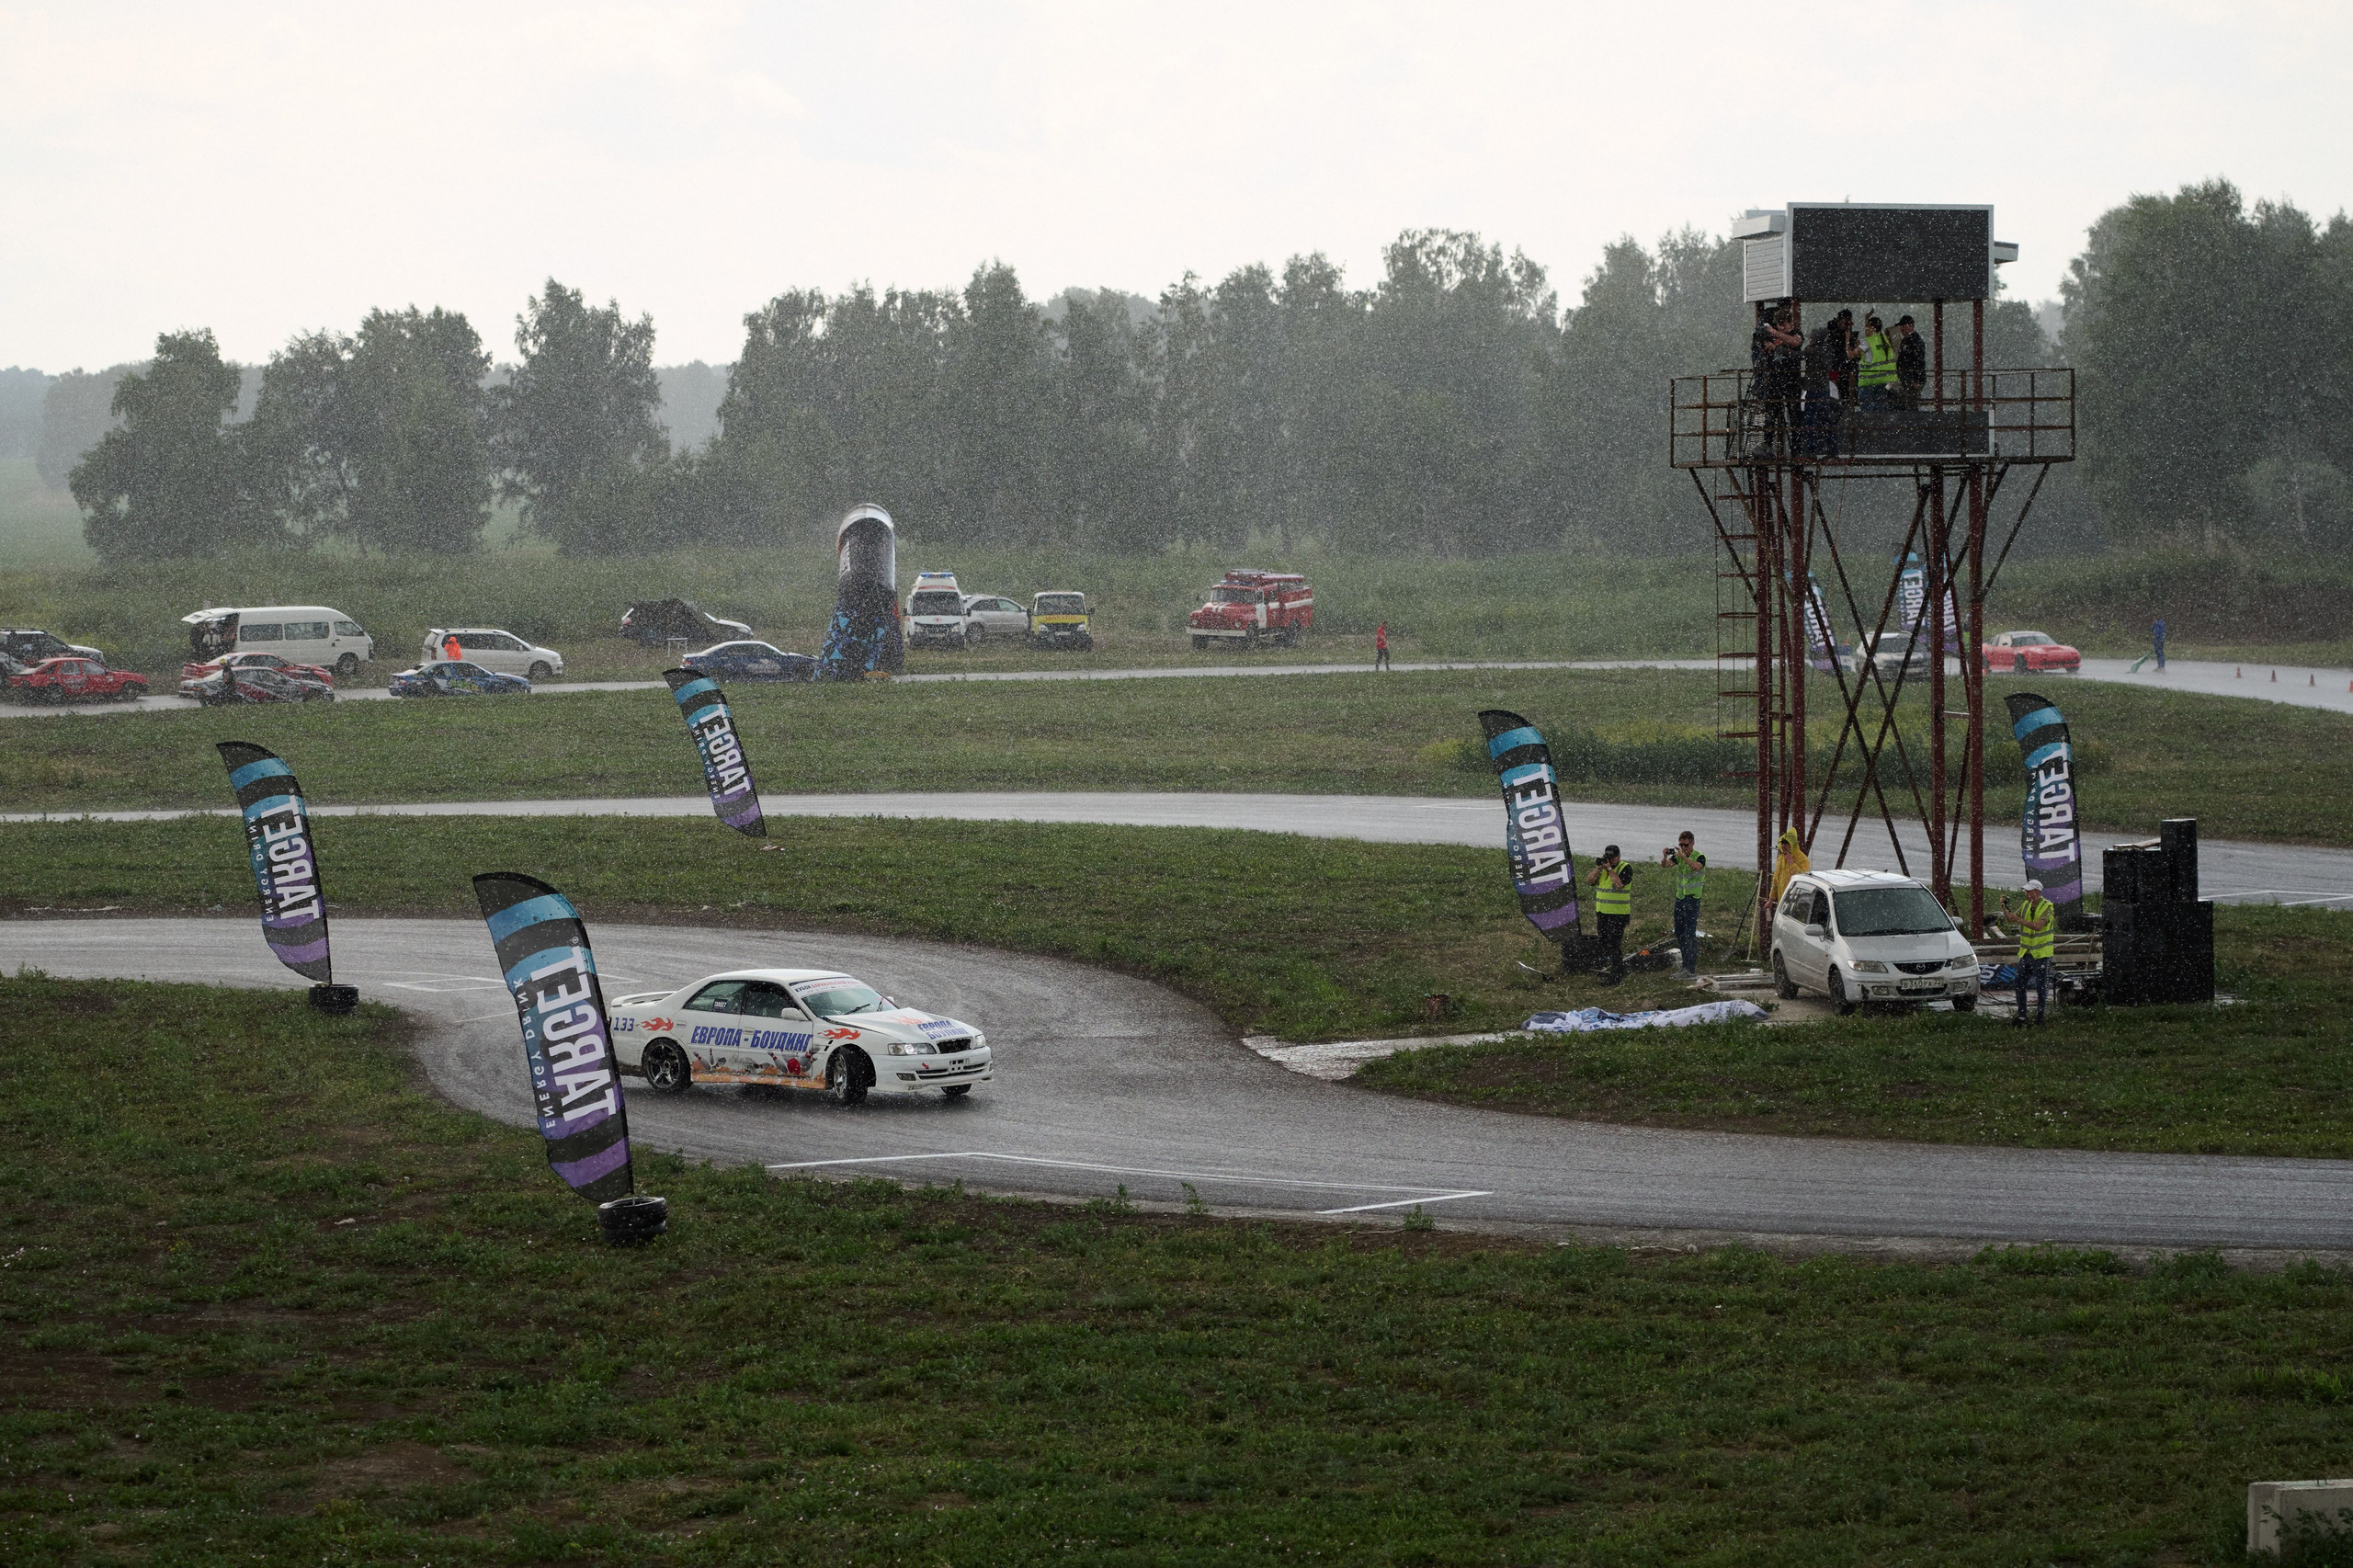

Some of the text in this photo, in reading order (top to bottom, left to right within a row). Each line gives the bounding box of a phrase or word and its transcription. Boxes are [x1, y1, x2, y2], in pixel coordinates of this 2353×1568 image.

[613, 1017, 635, 1031] 133
[917, 1020, 956, 1032] ЕВРОПА
[690, 1025, 744, 1046] ЕВРОПА
